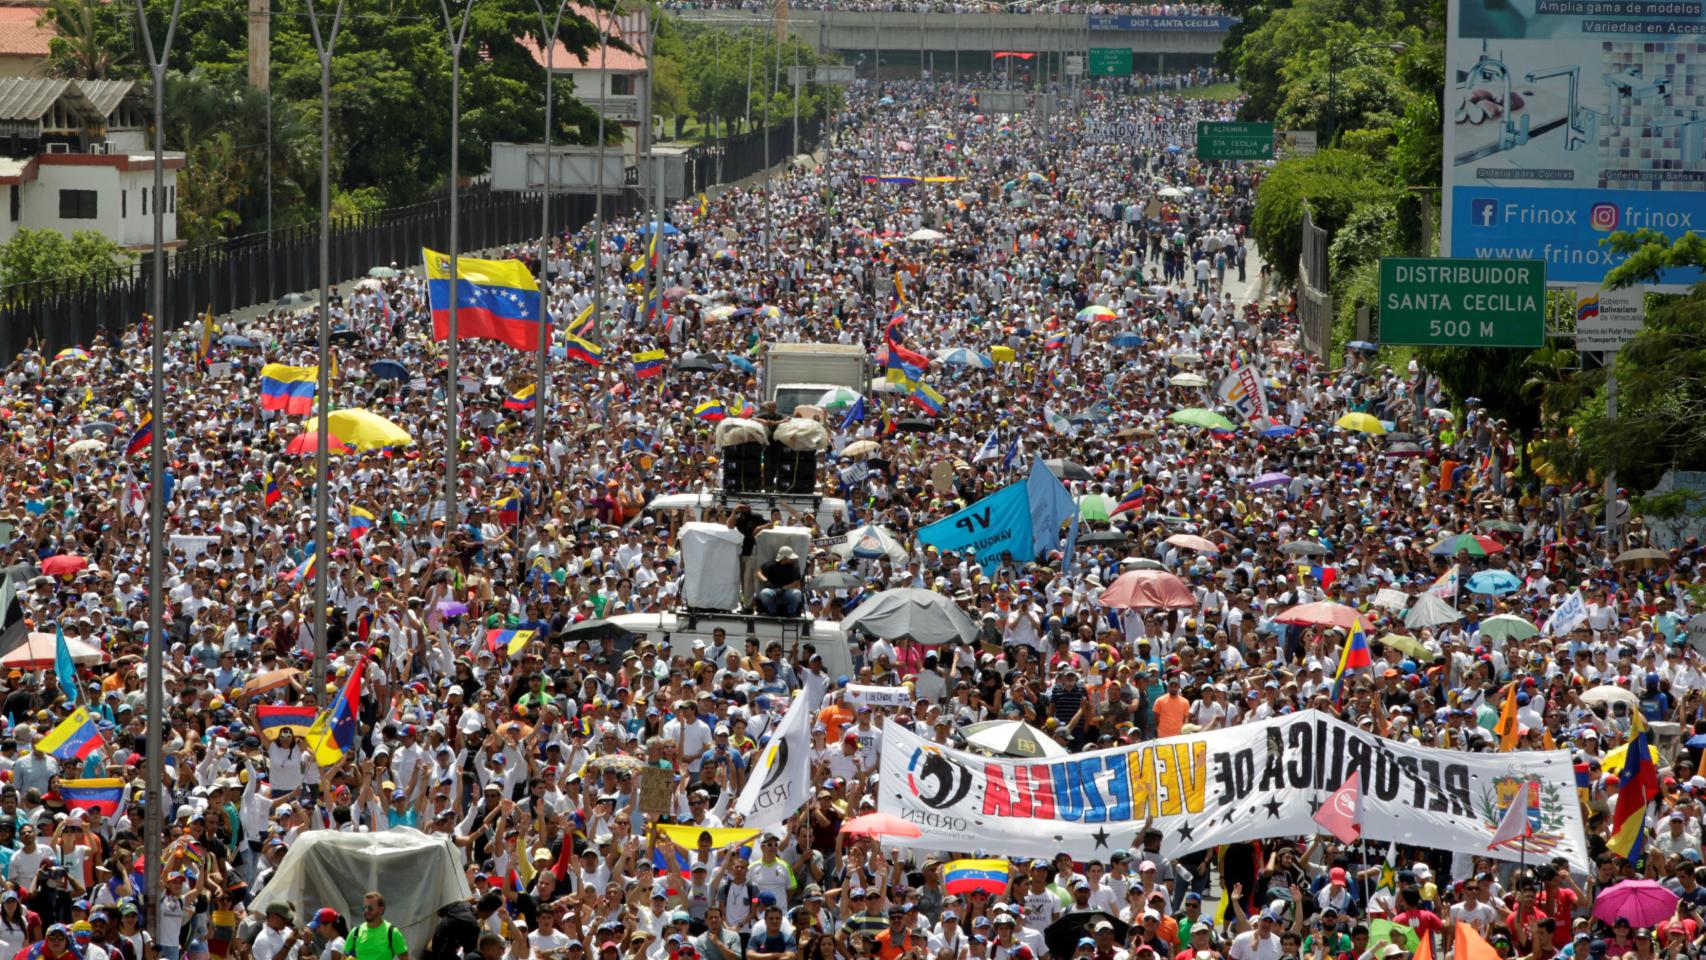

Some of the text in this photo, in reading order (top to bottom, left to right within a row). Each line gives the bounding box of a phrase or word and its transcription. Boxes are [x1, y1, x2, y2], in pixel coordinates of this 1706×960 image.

[1539, 2, 1700, 14] Amplia gama de modelos
[1130, 19, 1219, 28] DIST. SANTA CECILIA
[1585, 21, 1642, 33] Variedad
[1648, 24, 1662, 33] en
[1212, 139, 1258, 148] STA CECILIA
[1514, 171, 1536, 179] para
[1538, 169, 1573, 178] Cocinas
[1642, 173, 1662, 181] para
[1504, 203, 1577, 225] Frinox
[1395, 265, 1529, 285] DISTRIBUIDOR
[1387, 292, 1536, 312] SANTA CECILIA
[1599, 297, 1629, 305] Gobierno
[1599, 305, 1637, 313] Bolivariano
[1429, 319, 1494, 338] 500 M
[858, 735, 874, 747] UST
